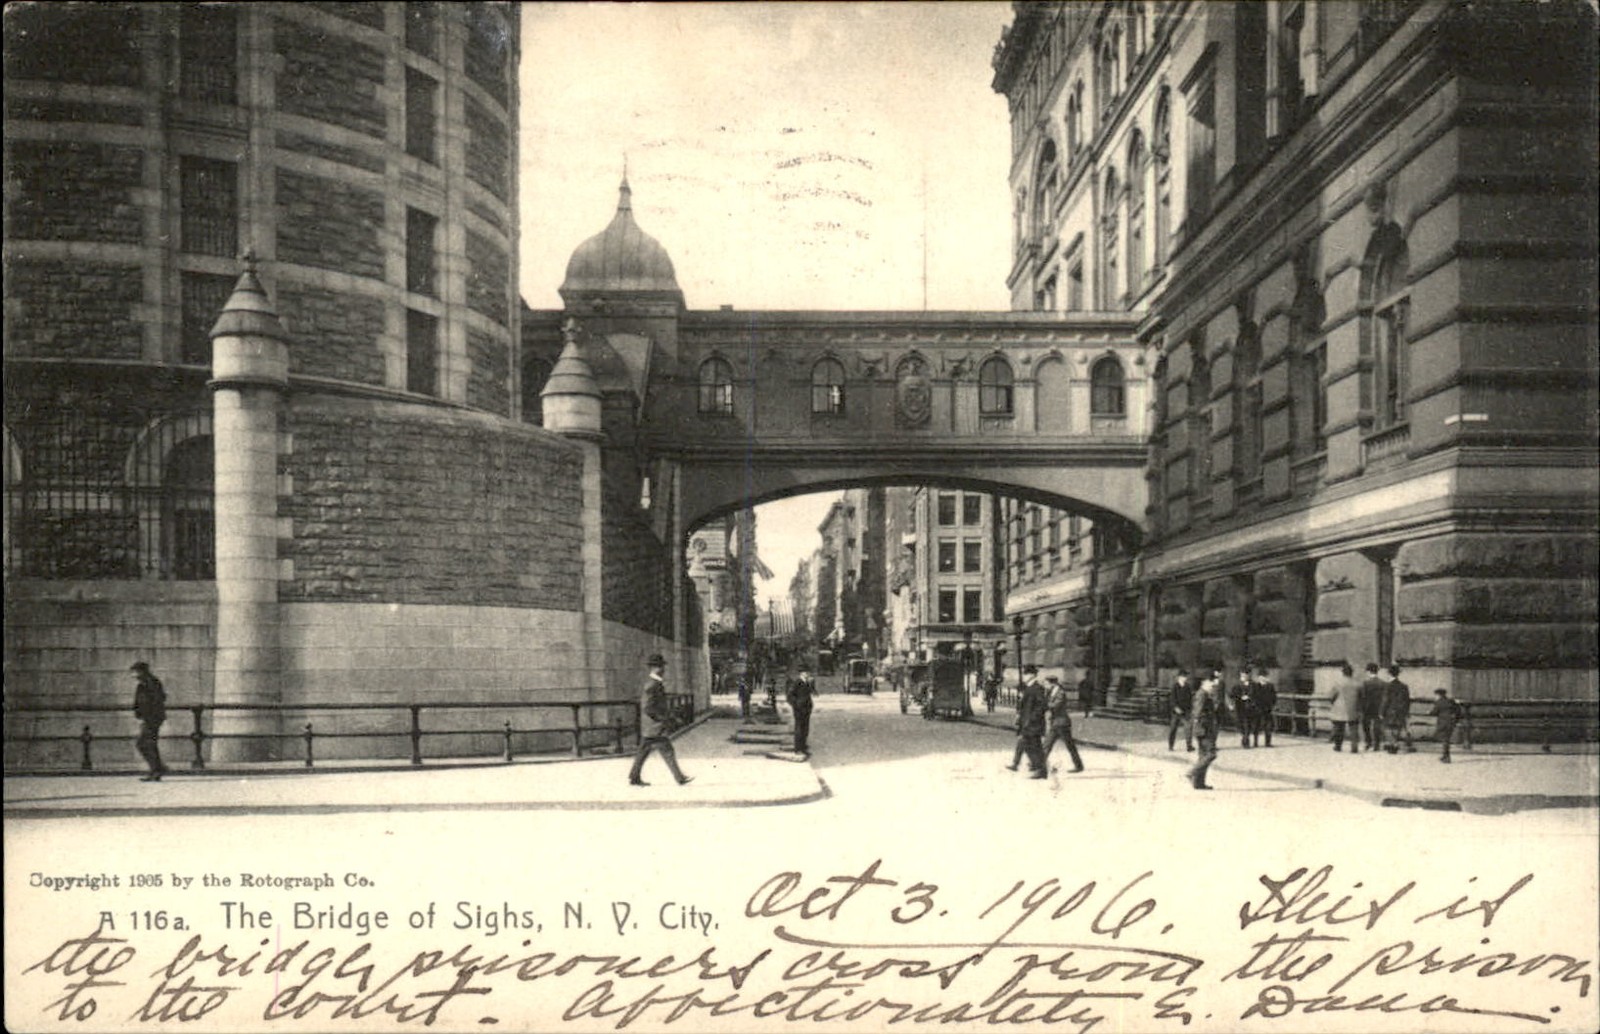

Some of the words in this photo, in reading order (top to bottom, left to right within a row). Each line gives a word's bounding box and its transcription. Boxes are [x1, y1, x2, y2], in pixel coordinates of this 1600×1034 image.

[745, 859, 897, 920] Oct
[891, 881, 947, 924] 3.
[980, 870, 1173, 947] 1906.
[1240, 865, 1417, 931] This
[1415, 872, 1534, 929] is
[24, 931, 136, 977] the
[151, 934, 377, 992] bridge
[390, 936, 773, 996] prisoners
[782, 937, 983, 990] cross
[980, 948, 1205, 1008] from
[1220, 928, 1349, 982] the
[1340, 937, 1592, 998] prison
[43, 979, 127, 1023] to
[131, 974, 243, 1023] the
[262, 962, 492, 1027] court
